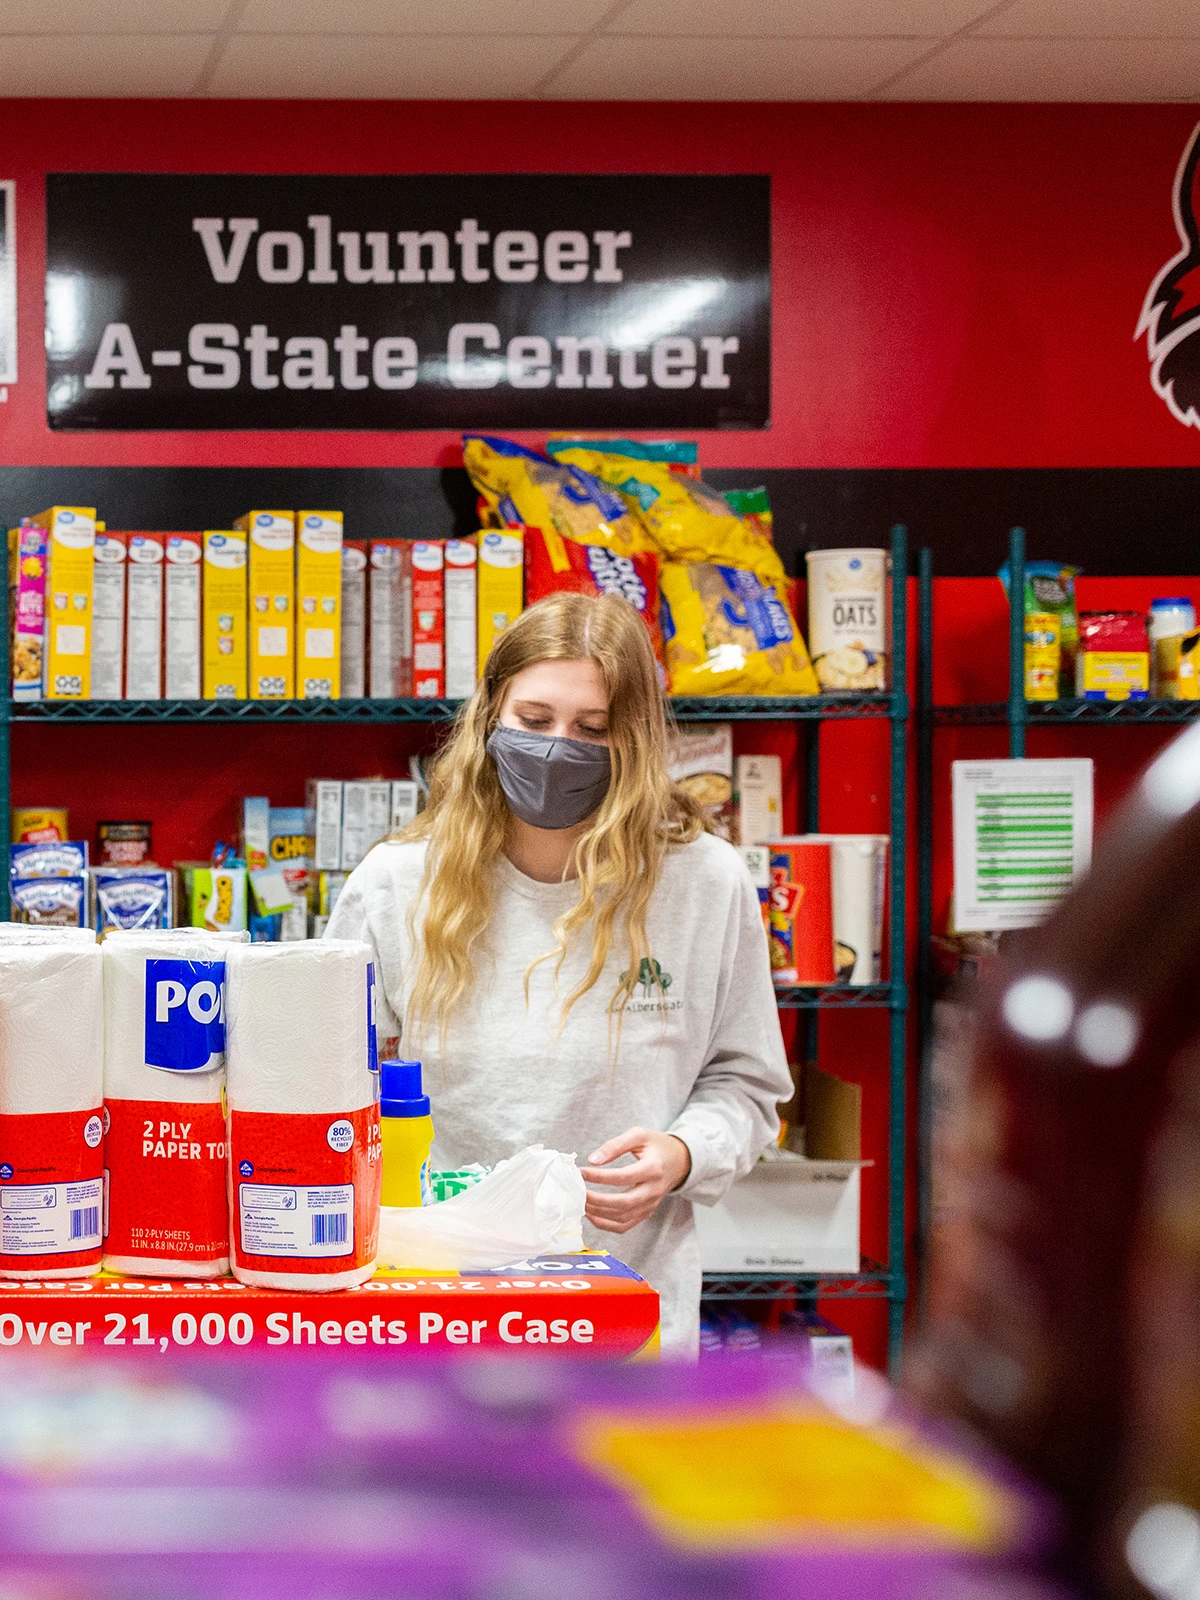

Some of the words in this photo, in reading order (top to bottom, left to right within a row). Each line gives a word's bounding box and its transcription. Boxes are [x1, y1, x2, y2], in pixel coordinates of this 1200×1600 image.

[193, 216, 631, 284] Volunteer
[84, 323, 419, 389] A-State
[447, 323, 739, 389] Center
[833, 606, 877, 626] OATS
[155, 979, 225, 1024] PO
[88, 1122, 100, 1132] 80%
[143, 1120, 154, 1138] 2
[160, 1121, 191, 1139] PLY
[333, 1126, 351, 1137] 80%
[368, 1126, 372, 1143] 2
[373, 1123, 382, 1141] PL
[142, 1140, 201, 1160] PAPER
[206, 1141, 228, 1160] TO
[368, 1144, 382, 1163] PAP
[131, 1228, 144, 1238] 110
[145, 1229, 164, 1239] 2-PLY
[164, 1230, 191, 1240] SHEETS
[131, 1239, 139, 1248] 11
[140, 1240, 150, 1249] IN.
[155, 1240, 166, 1250] 8.8
[194, 1244, 206, 1252] cm
[496, 1279, 592, 1291] Over
[103, 1312, 254, 1353] 21,000
[266, 1311, 408, 1346] Sheets
[419, 1311, 487, 1345] Per
[499, 1310, 595, 1345] Case
